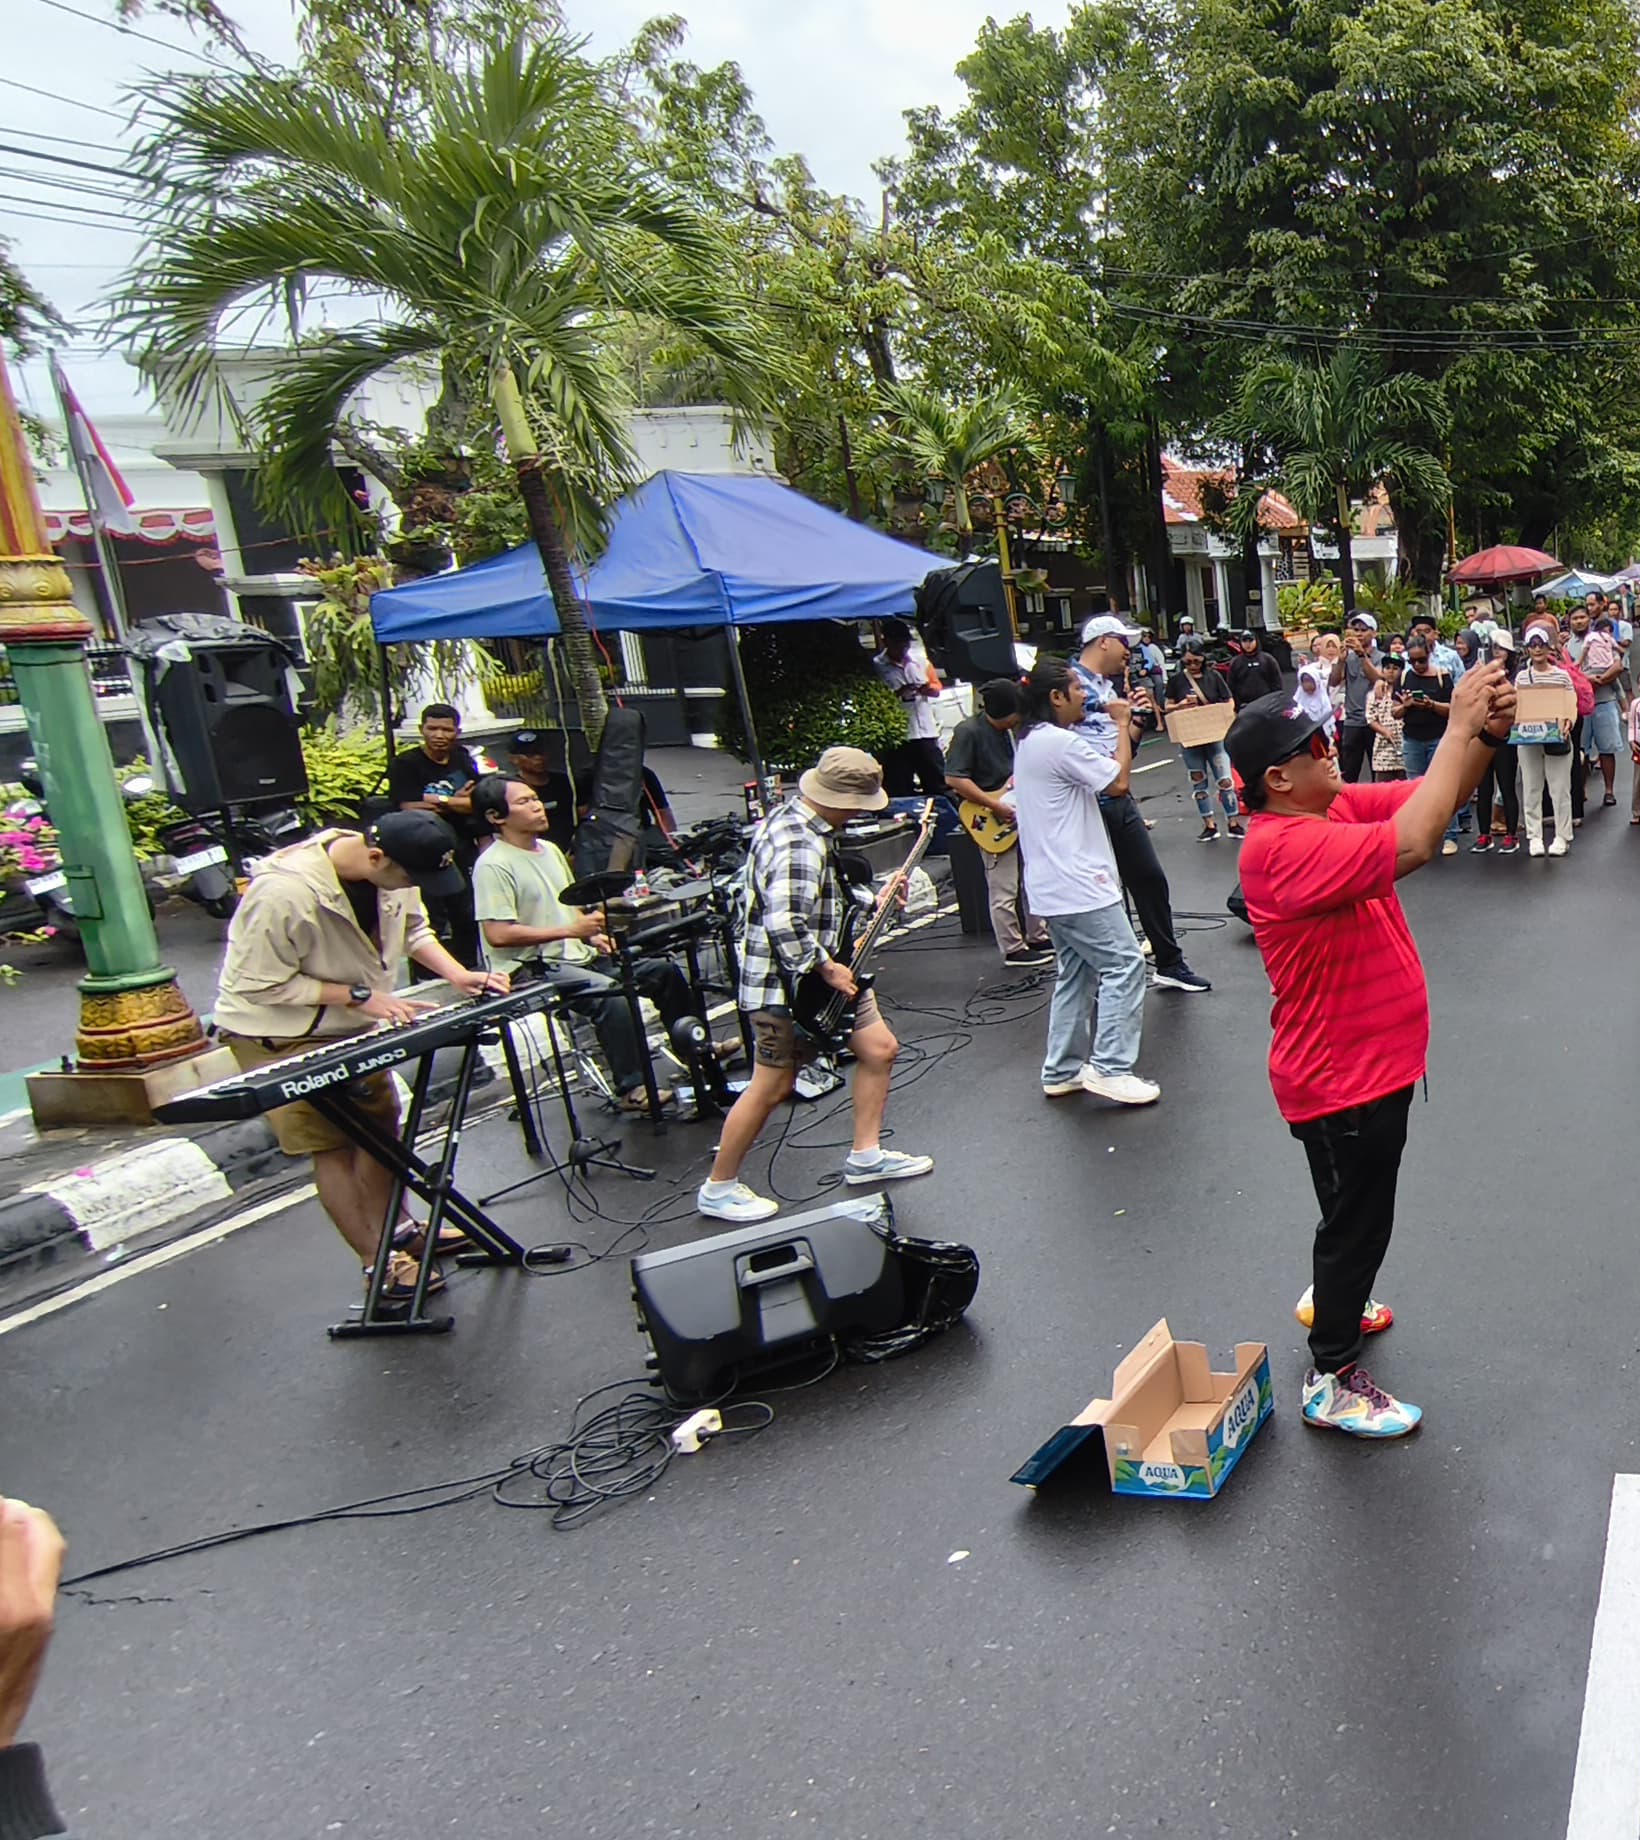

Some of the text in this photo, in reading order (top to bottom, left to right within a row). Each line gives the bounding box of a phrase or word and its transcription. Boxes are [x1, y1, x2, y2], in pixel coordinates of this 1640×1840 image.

[281, 1063, 350, 1098] Roland
[1227, 1388, 1255, 1440] AQUA
[1145, 1467, 1178, 1479] AQUA
